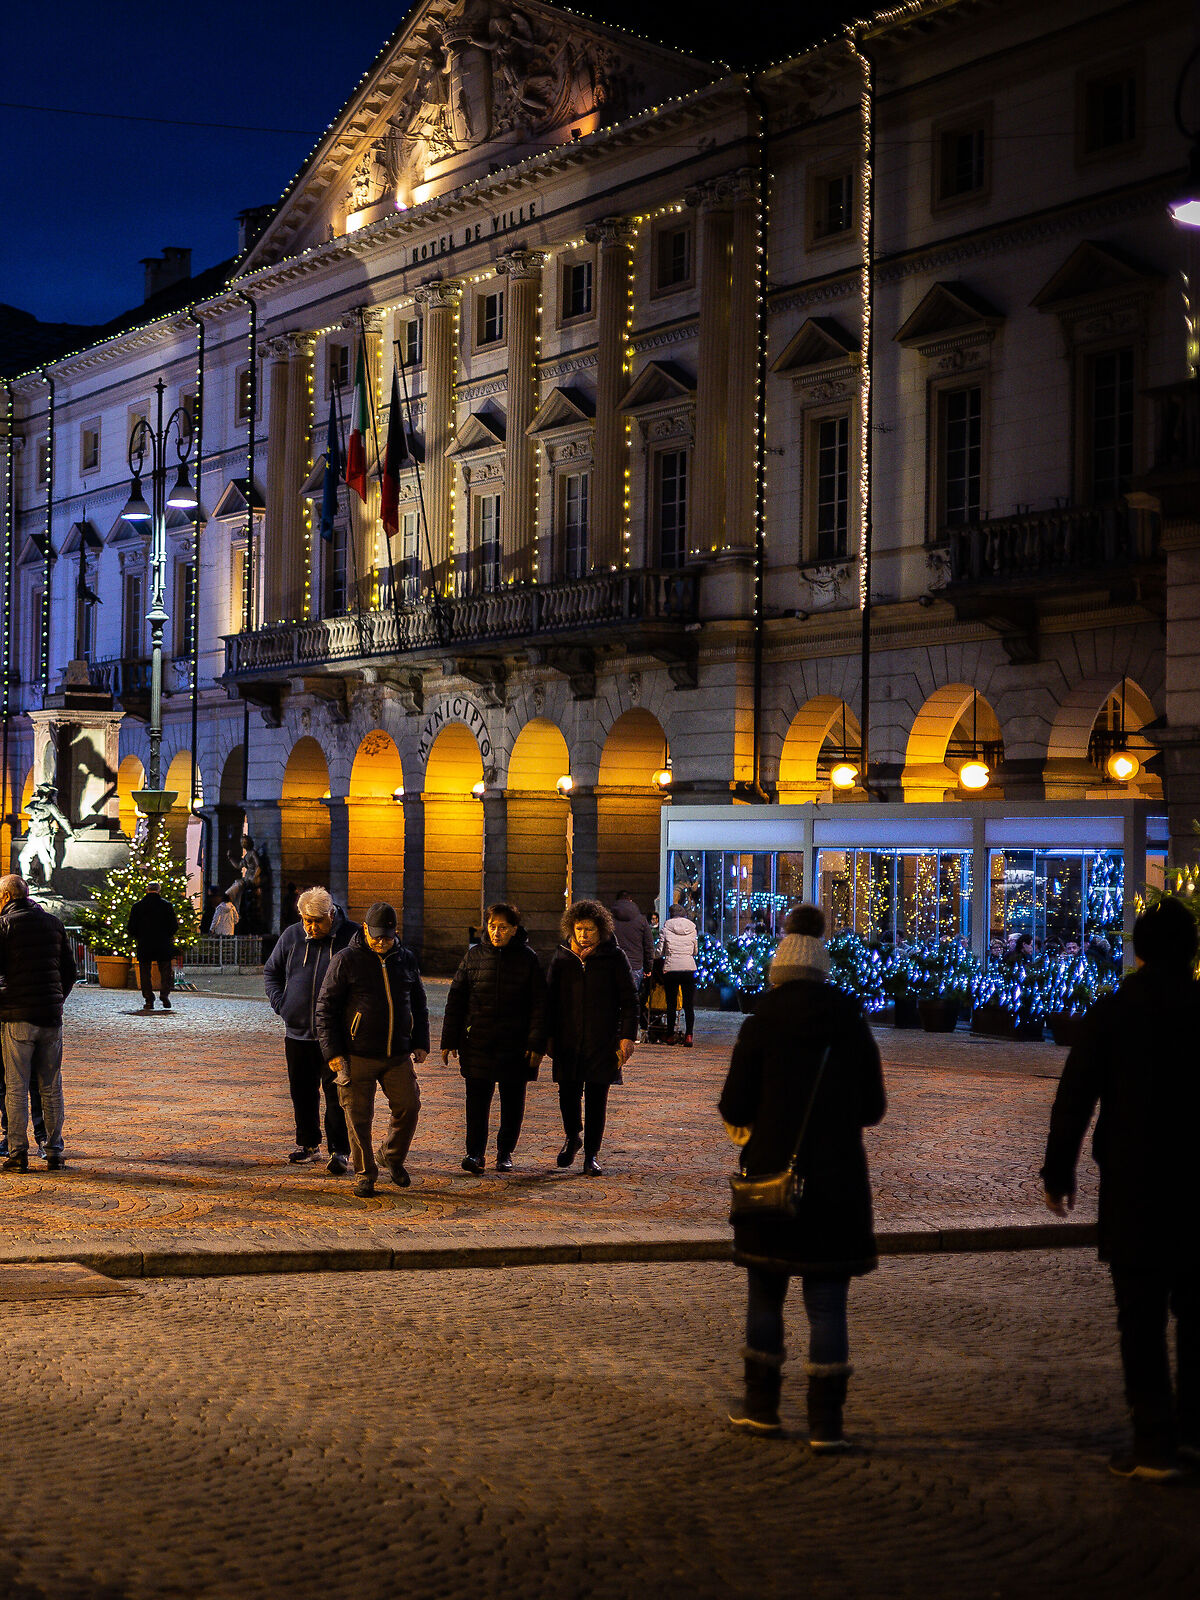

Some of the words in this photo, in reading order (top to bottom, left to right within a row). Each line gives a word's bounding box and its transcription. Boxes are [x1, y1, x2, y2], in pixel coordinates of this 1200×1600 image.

[412, 234, 456, 263] HOTEL
[465, 223, 481, 243] DE
[491, 202, 537, 232] VILLE
